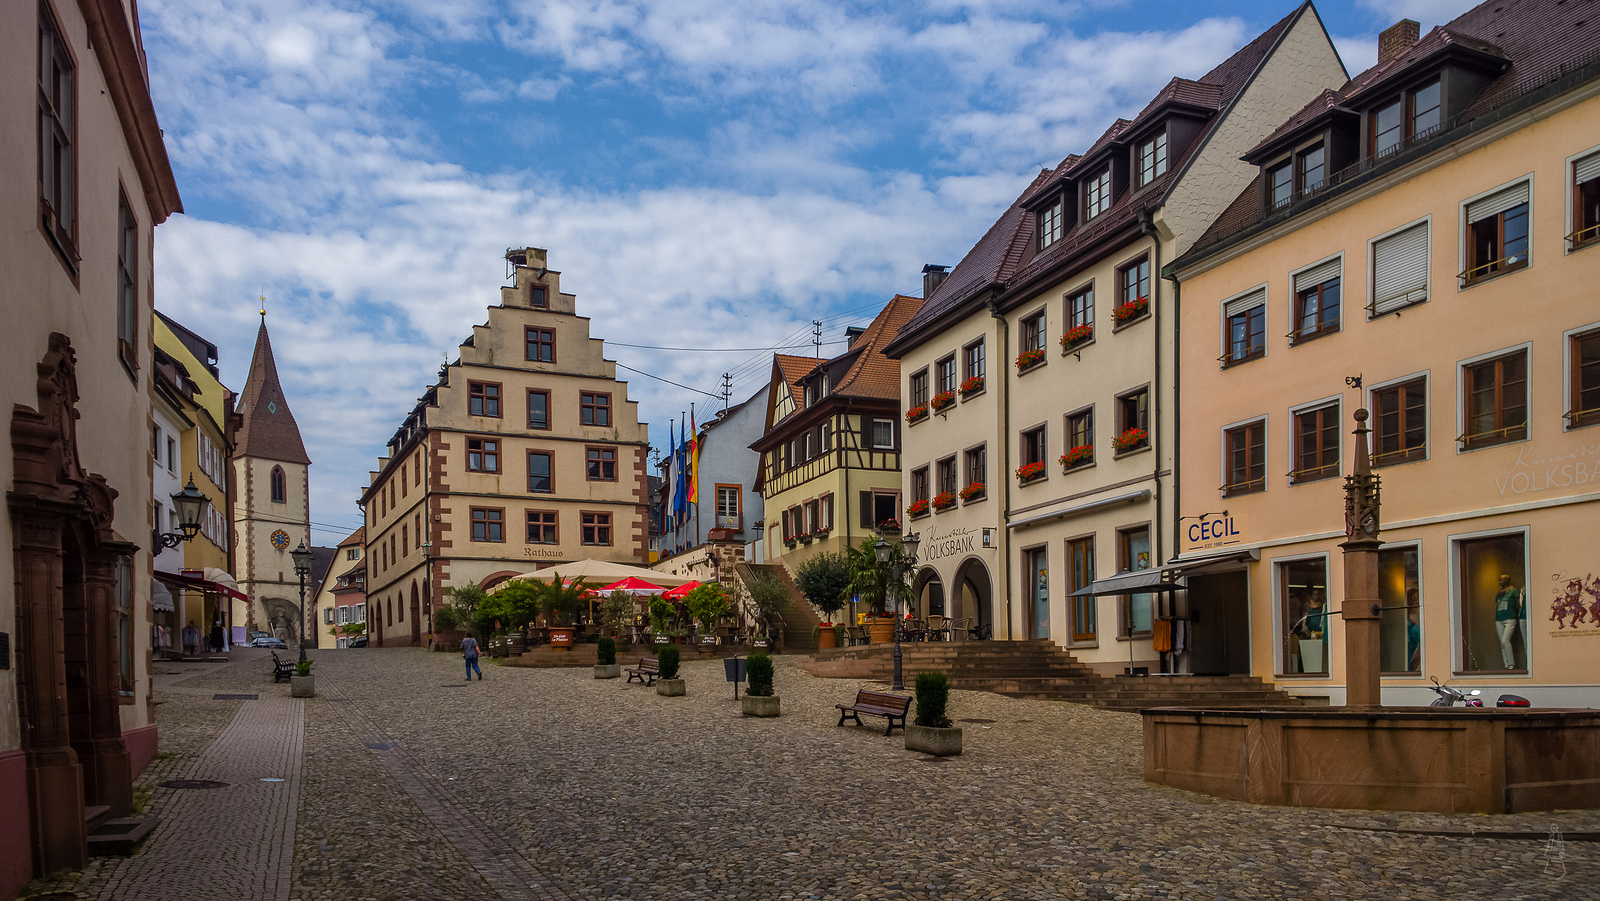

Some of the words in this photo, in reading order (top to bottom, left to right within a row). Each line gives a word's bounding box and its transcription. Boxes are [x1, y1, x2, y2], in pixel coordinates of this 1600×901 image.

[1189, 517, 1240, 542] CECIL
[524, 547, 564, 558] Rathaus
[924, 536, 975, 561] VOLKSBANK
